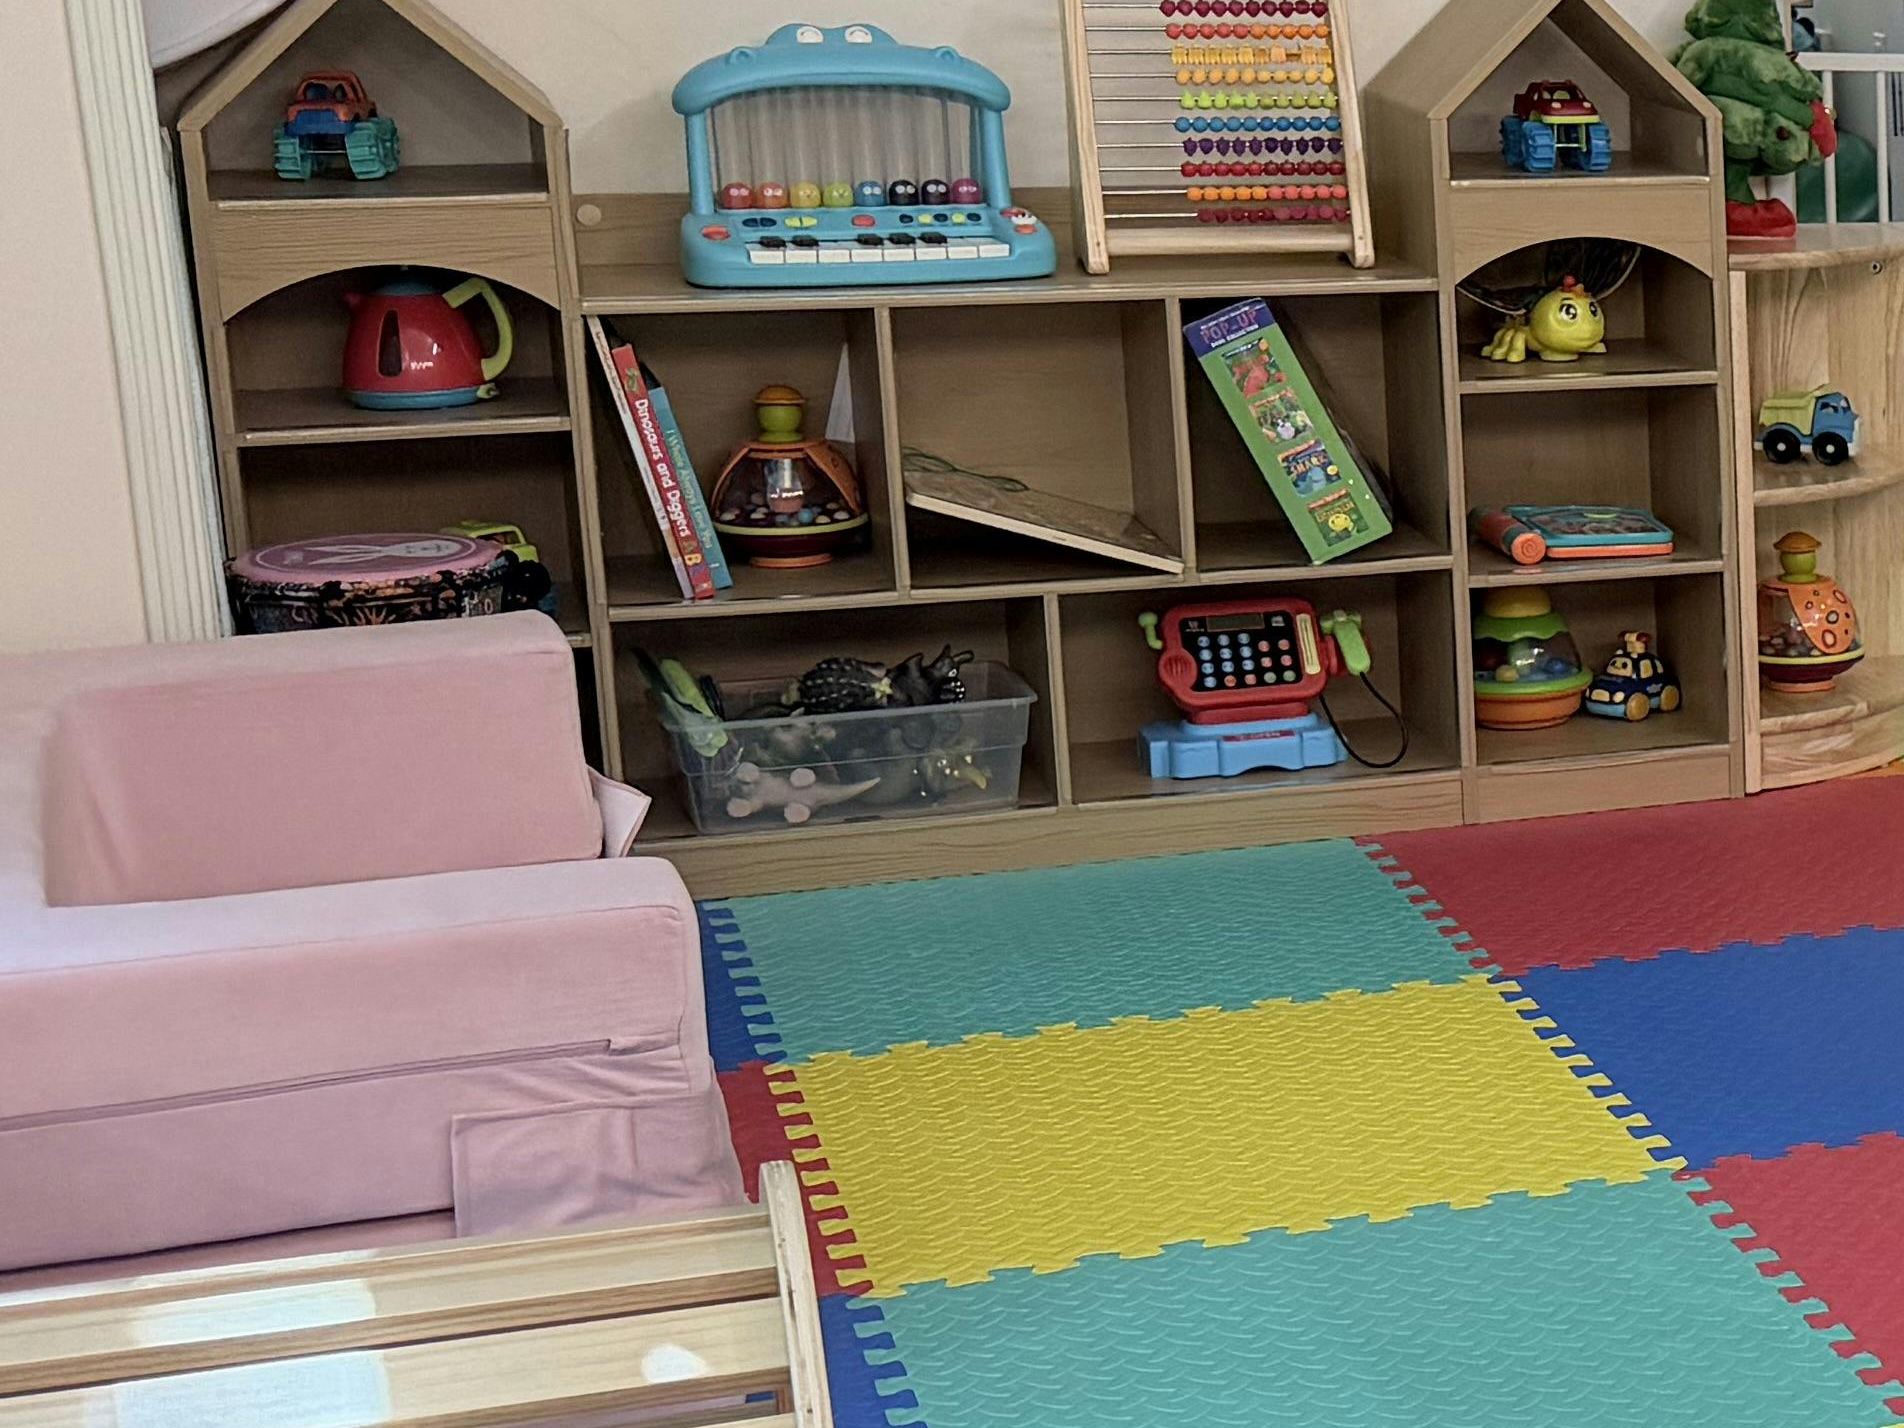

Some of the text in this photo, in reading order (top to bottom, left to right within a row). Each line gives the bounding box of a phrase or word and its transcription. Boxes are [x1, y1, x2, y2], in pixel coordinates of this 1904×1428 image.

[634, 398, 664, 462] Dinosaurs
[656, 461, 676, 489] and
[666, 489, 692, 537] Diggers
